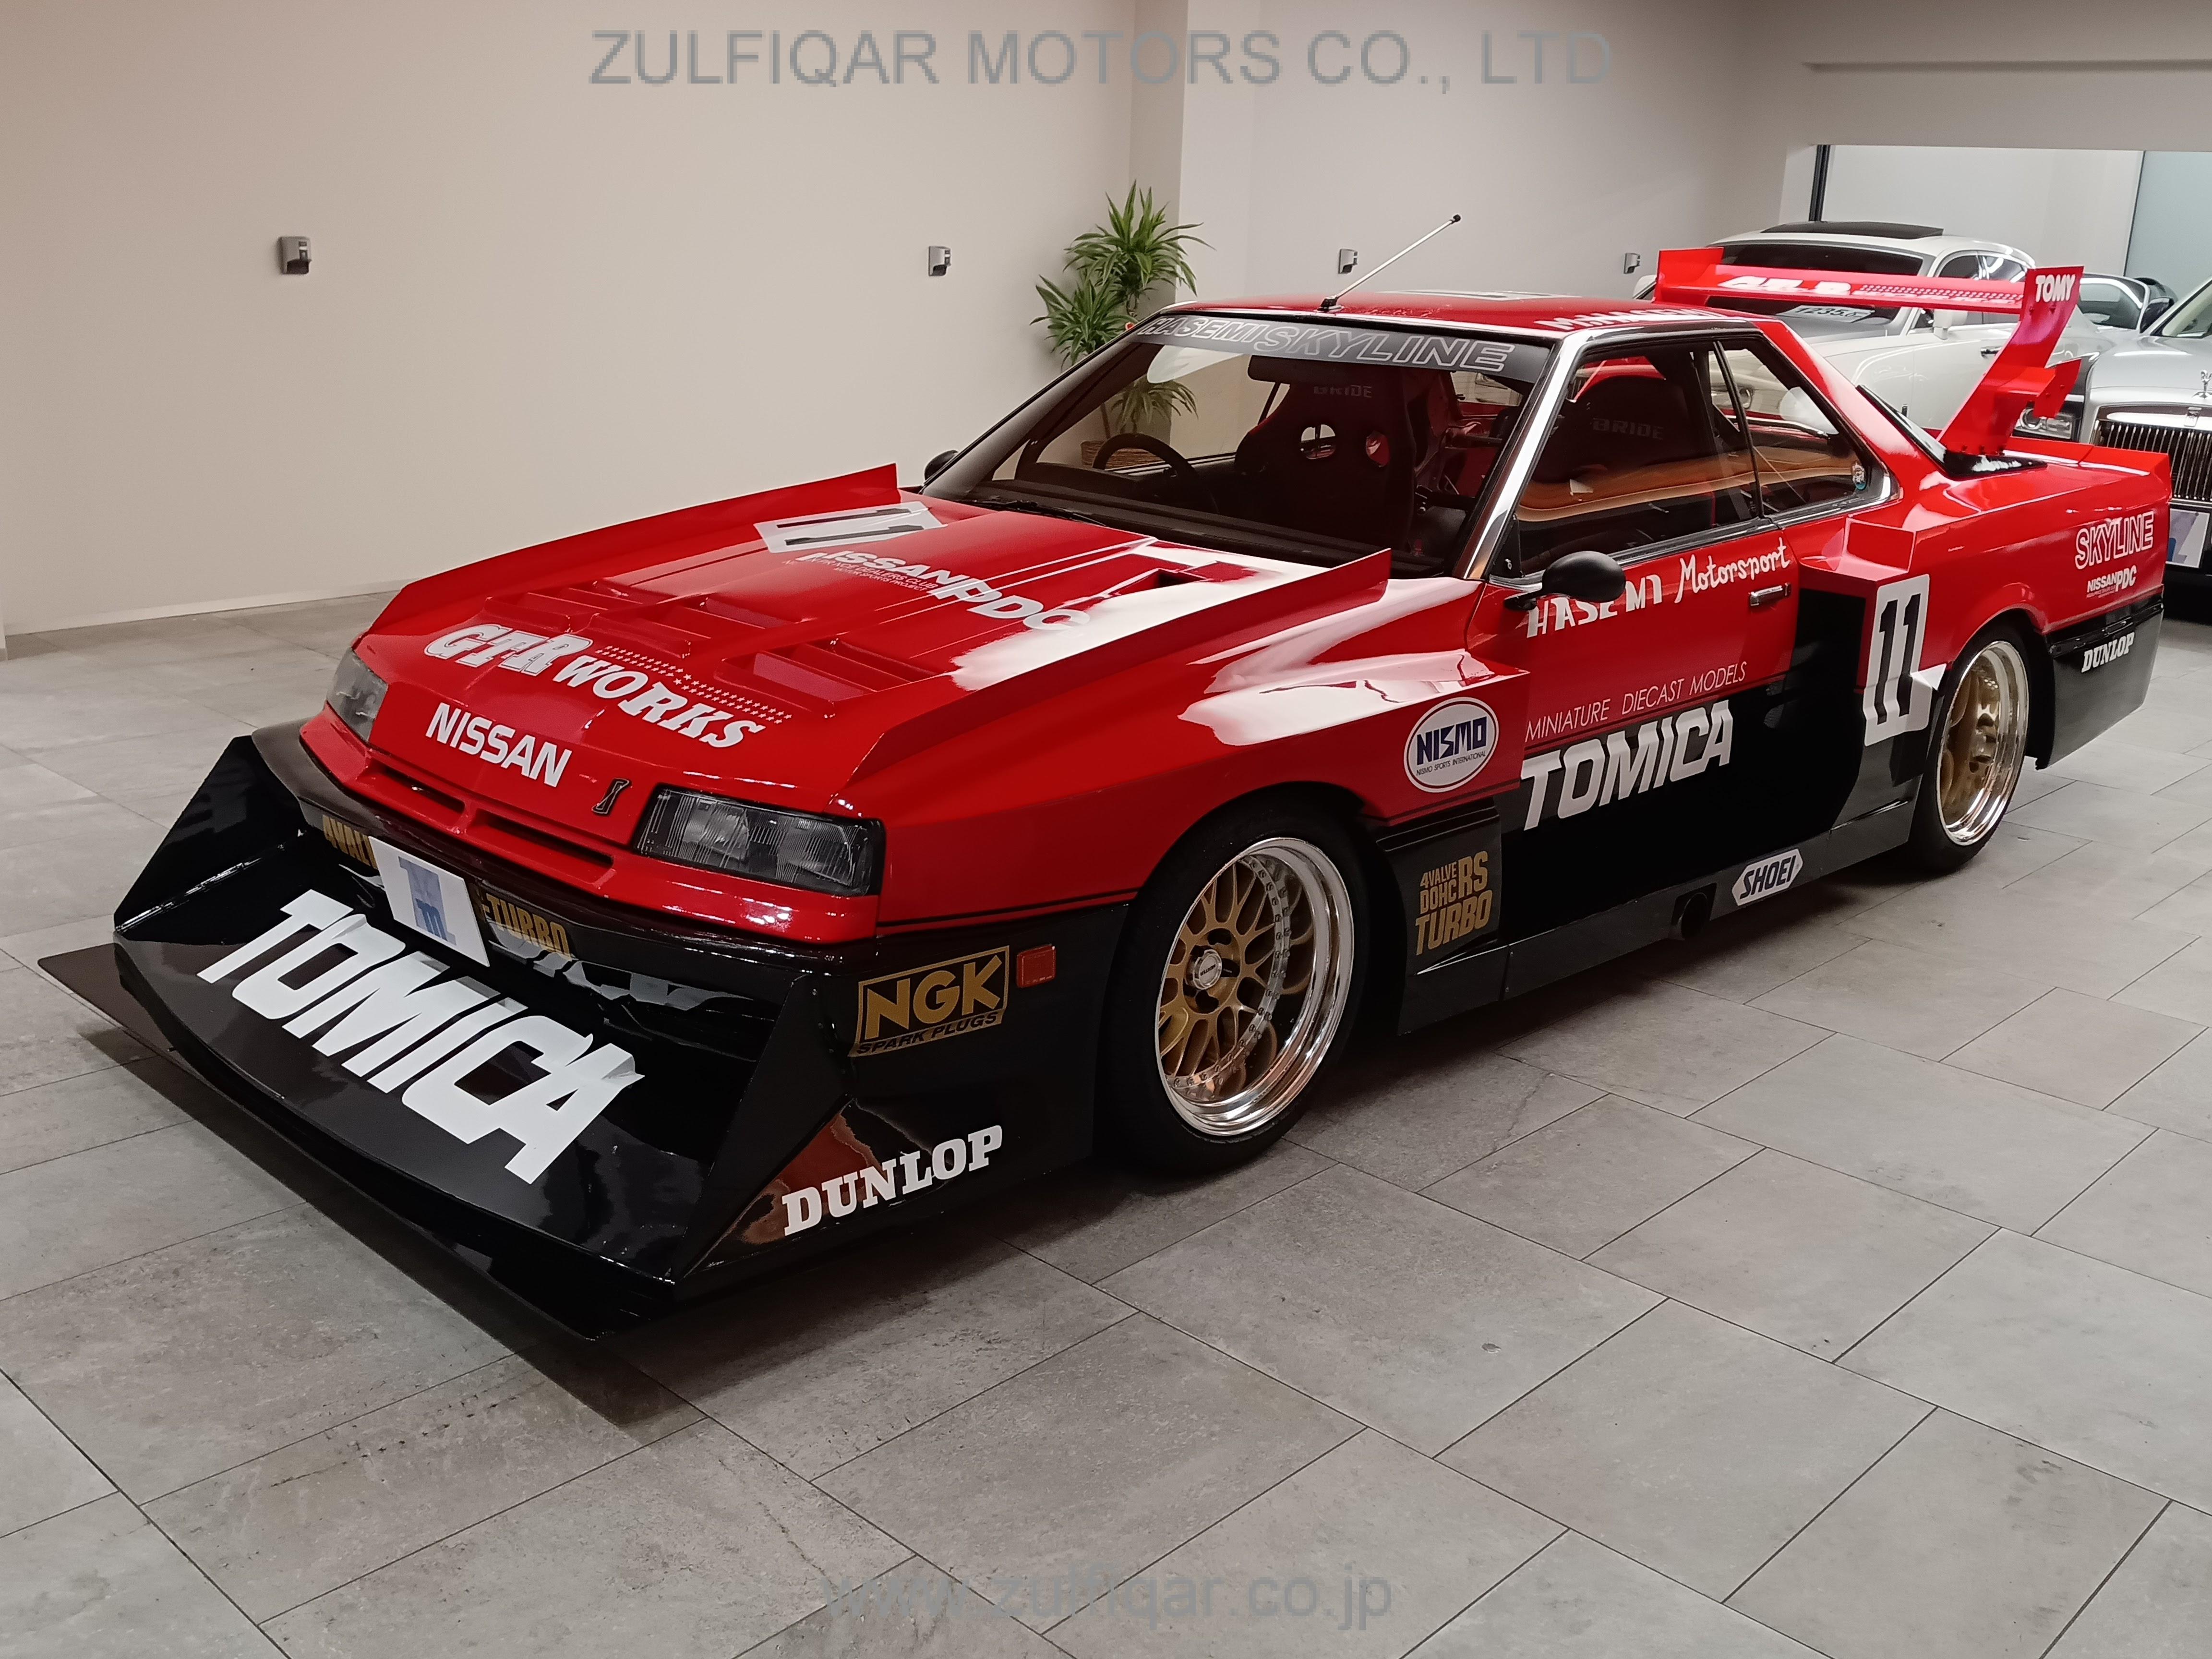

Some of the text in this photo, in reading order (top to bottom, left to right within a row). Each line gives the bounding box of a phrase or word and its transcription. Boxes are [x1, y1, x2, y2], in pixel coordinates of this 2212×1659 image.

[2035, 274, 2076, 302] TOMY
[1137, 317, 1516, 372] HASEMI SKYLINE
[1675, 537, 1791, 603] Motorsport
[2074, 510, 2154, 570] SKYLINE
[906, 578, 938, 589] CLUB
[1875, 593, 1921, 725] 11
[2081, 632, 2135, 673] DUNLOP
[553, 654, 766, 748] WORKS
[1525, 661, 1747, 743] MINIATURE DIECAST MODELS
[425, 702, 572, 788] NISSAN
[1416, 750, 1486, 776] NISMO SPORTS INTERNATIONAL
[1417, 717, 1487, 765] NISMO
[1521, 700, 1733, 831] TOMICA
[1420, 851, 1488, 899] 4VALVE RS
[1420, 879, 1457, 914] DOHC
[1739, 854, 1797, 900] SHOEI
[1415, 890, 1493, 956] TURBO
[865, 954, 1003, 1039] NGK
[196, 889, 645, 1184] TOMICA
[856, 1010, 999, 1055] SPARK PLUGS
[782, 1125, 1002, 1236] DUNLOP
